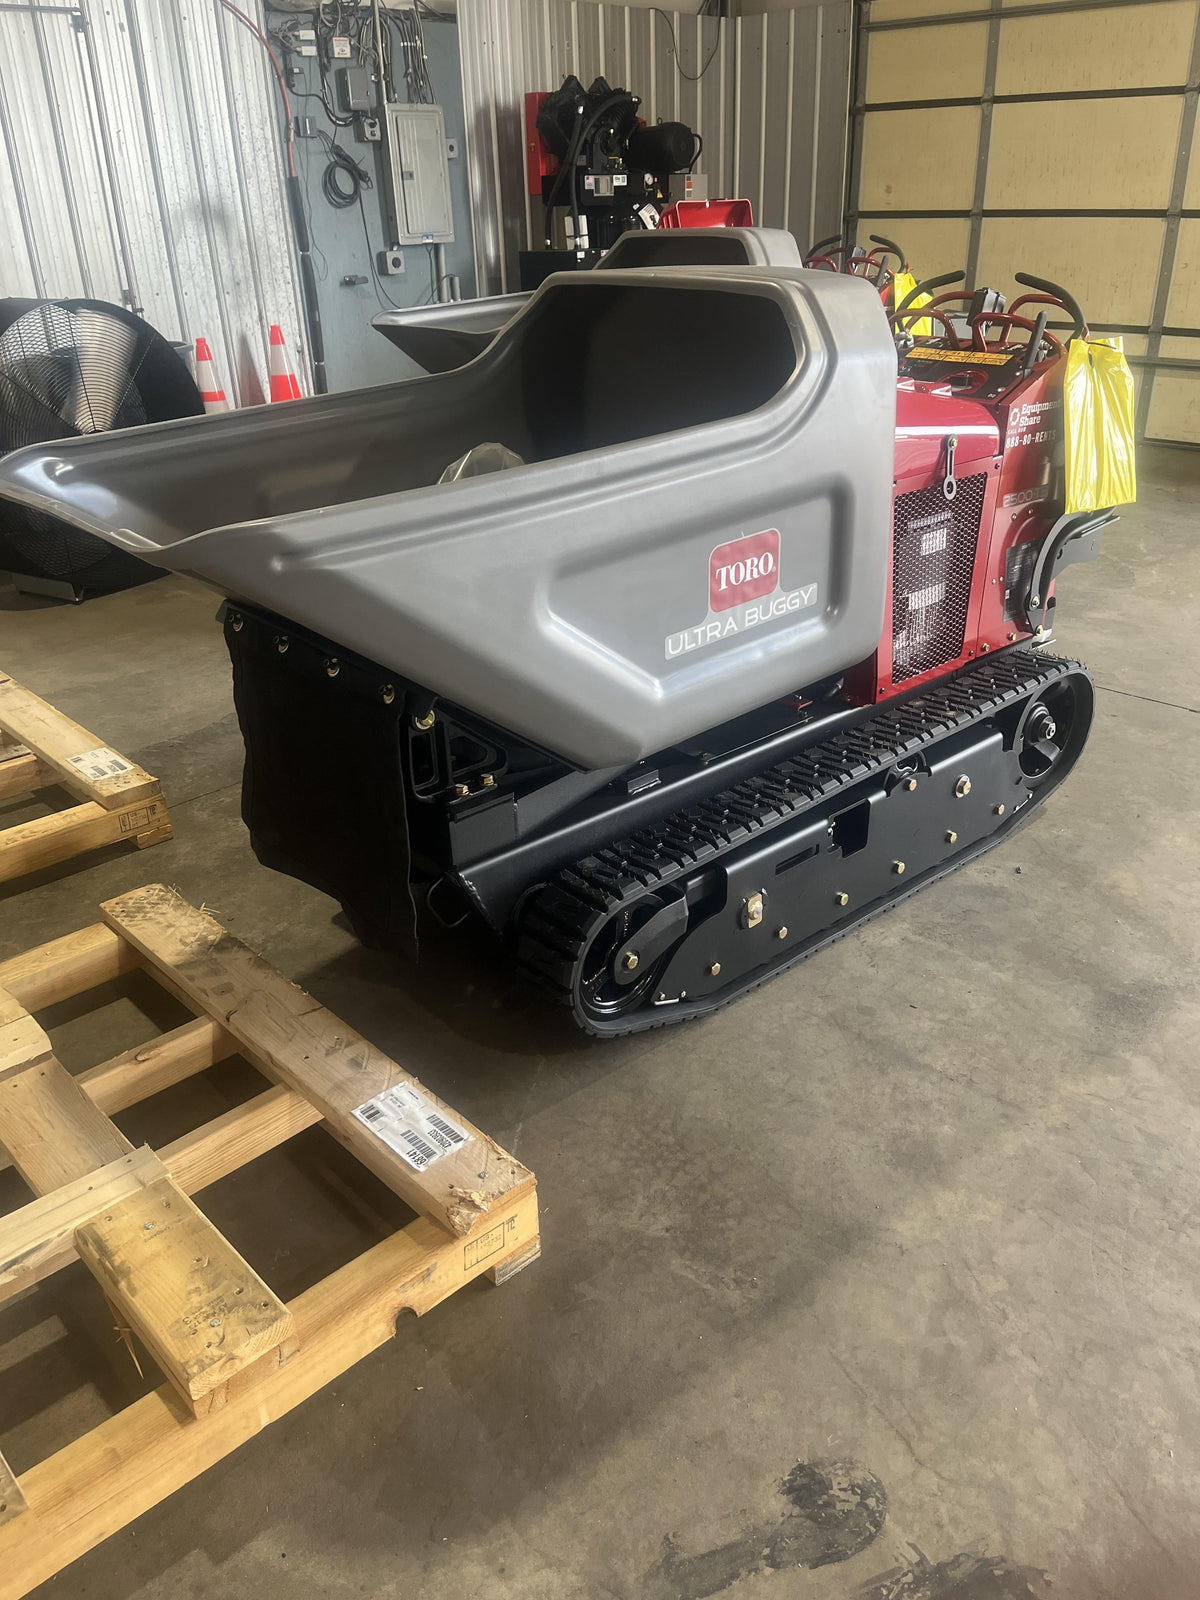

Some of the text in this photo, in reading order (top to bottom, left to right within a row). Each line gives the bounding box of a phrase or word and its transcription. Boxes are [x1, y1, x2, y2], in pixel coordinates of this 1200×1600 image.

[1019, 415, 1041, 427] Share
[715, 552, 774, 592] TORO
[668, 588, 814, 655] ULTRA BUGGY
